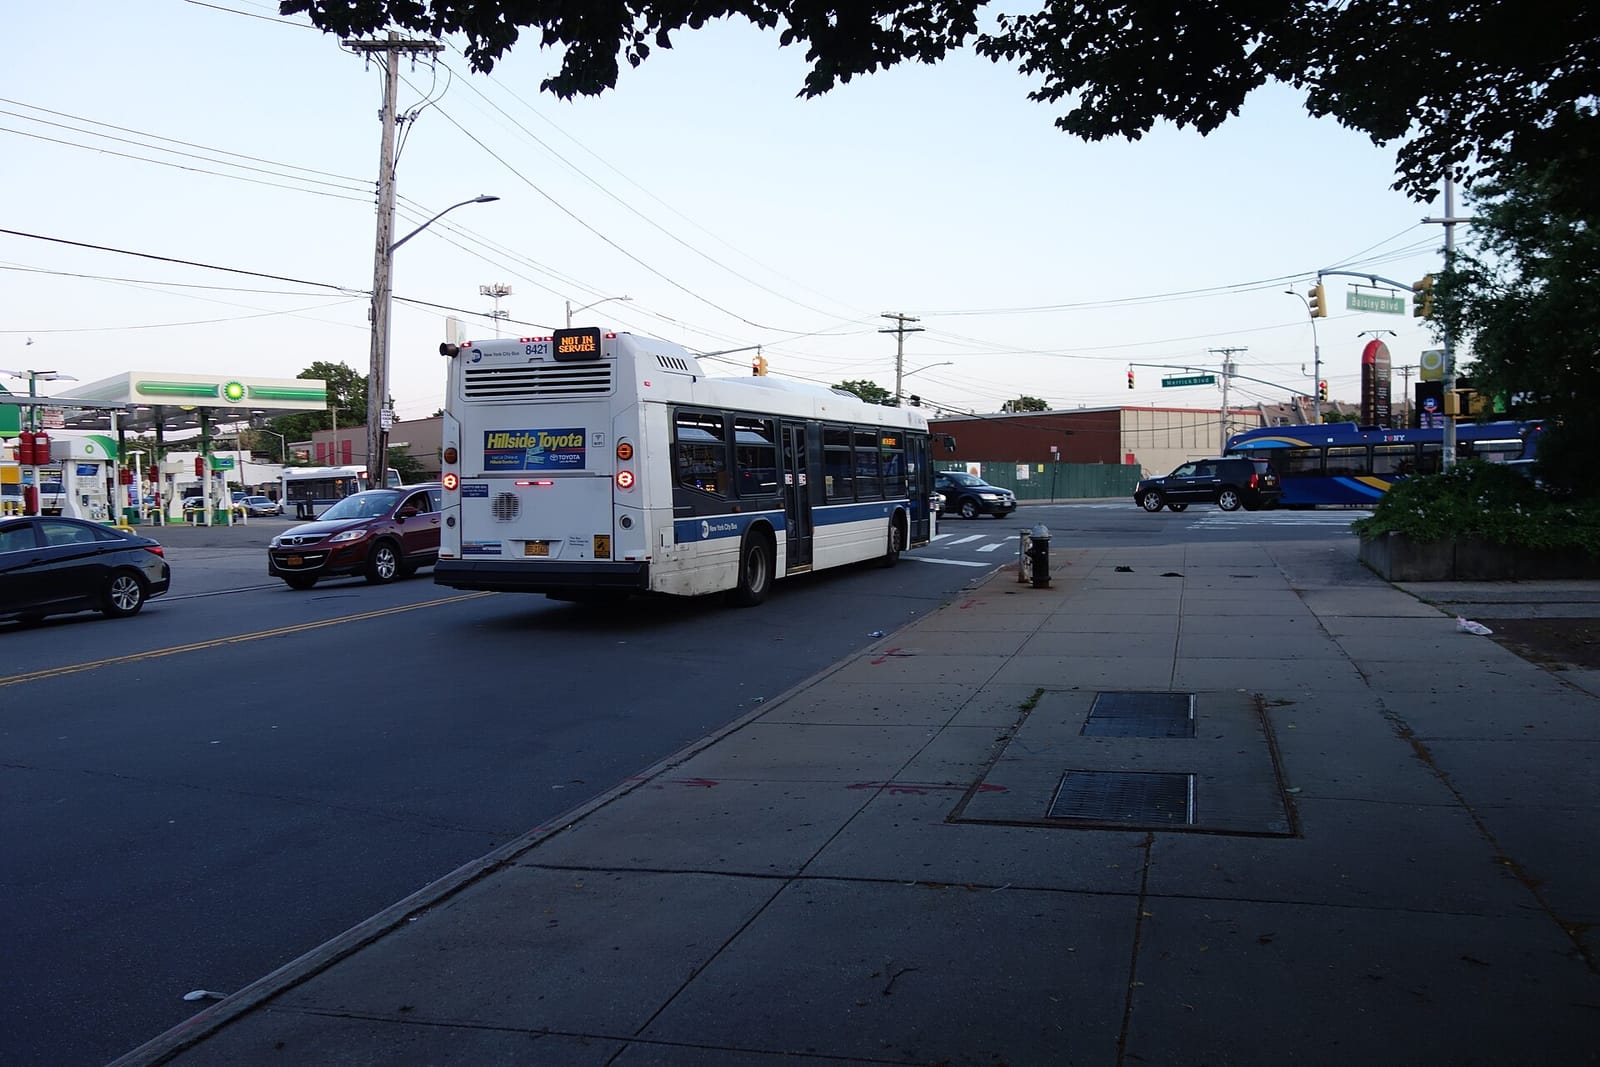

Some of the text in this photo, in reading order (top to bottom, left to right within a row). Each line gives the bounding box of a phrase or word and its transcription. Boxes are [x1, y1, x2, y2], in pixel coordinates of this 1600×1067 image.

[1351, 296, 1399, 311] Baisley Blvd
[561, 335, 593, 346] NOT IN
[526, 343, 548, 355] 8421
[559, 343, 596, 353] SERVICE
[1166, 378, 1192, 386] Merrick
[487, 431, 583, 451] Hillside Toyota
